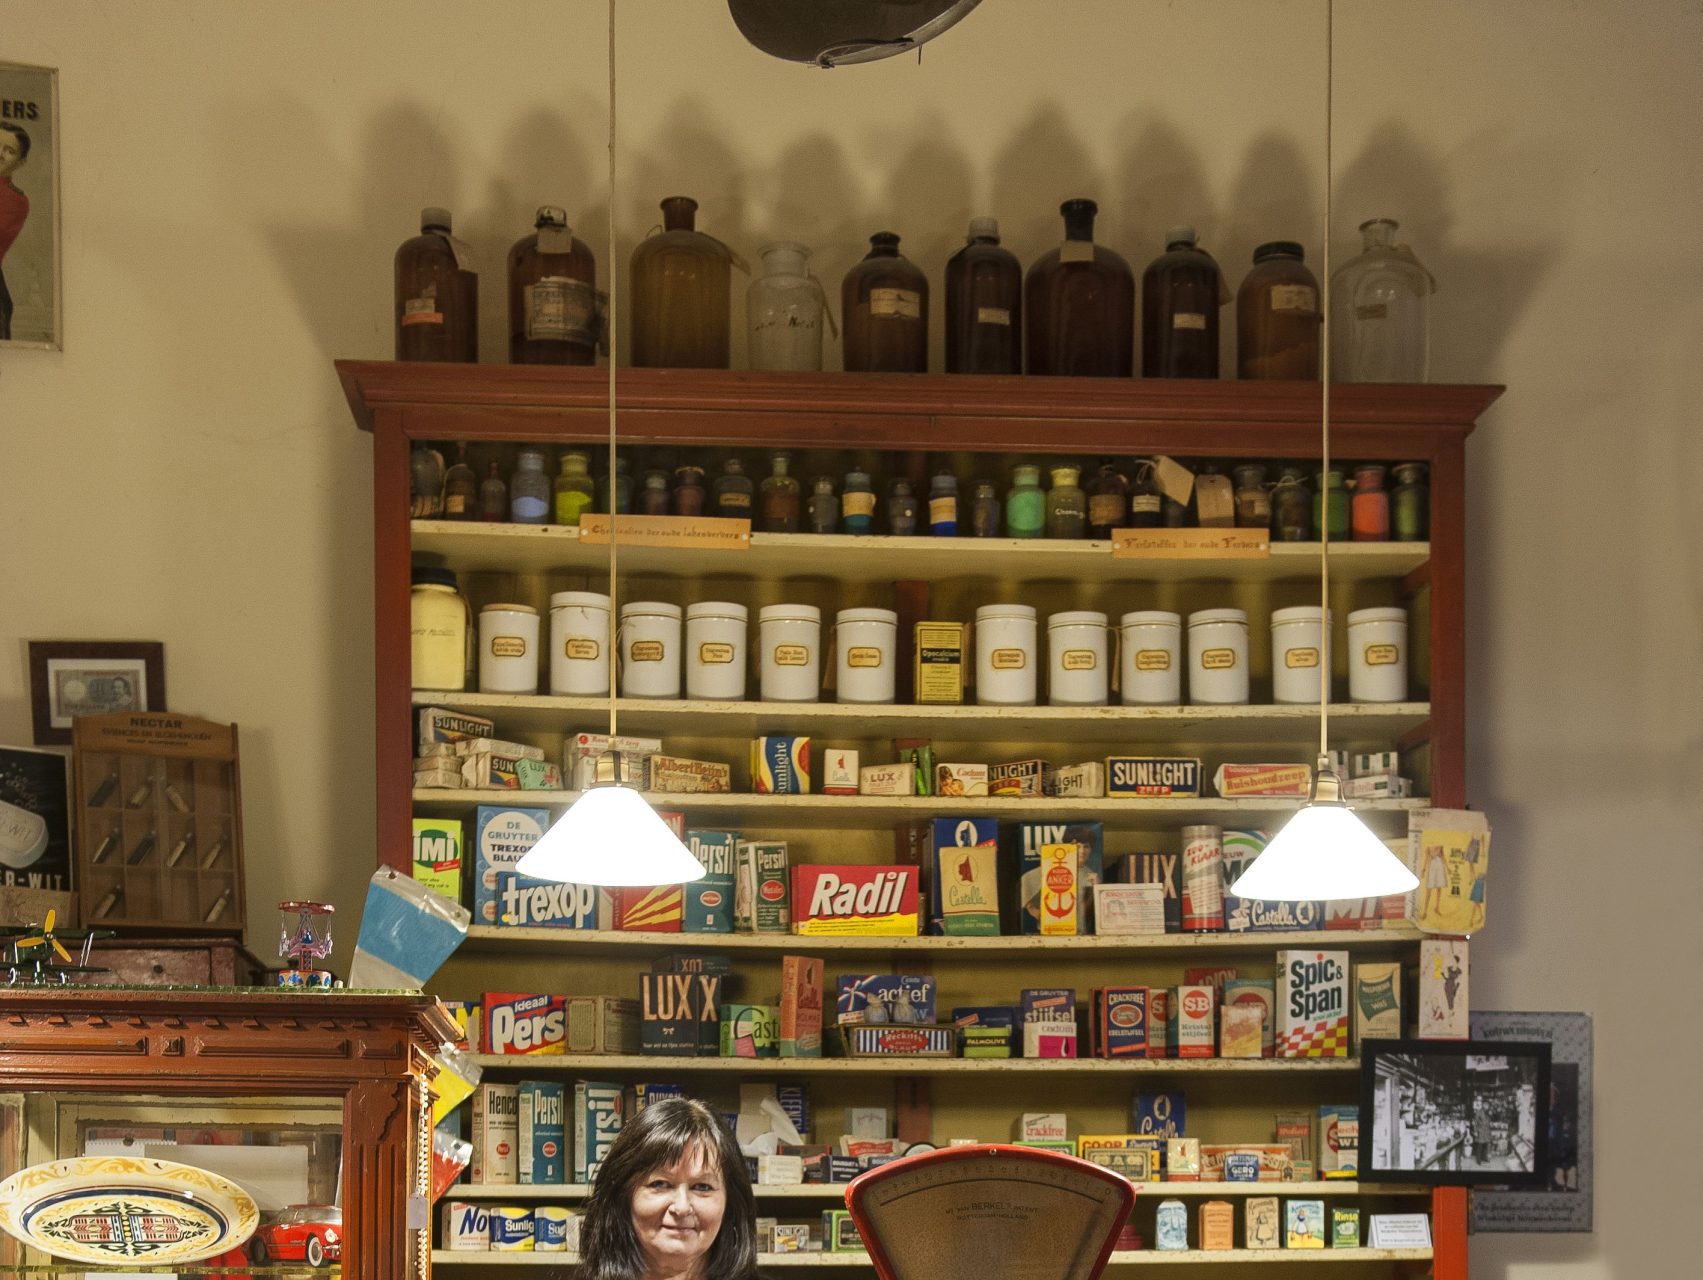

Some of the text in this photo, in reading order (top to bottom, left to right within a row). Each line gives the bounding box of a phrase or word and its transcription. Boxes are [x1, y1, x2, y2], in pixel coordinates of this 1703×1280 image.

[2, 101, 39, 120] ERS
[129, 717, 182, 729] NECTAR
[434, 716, 491, 737] SUNLIGHT
[870, 772, 895, 783] LUX
[1114, 762, 1195, 786] SUNLIGHT
[506, 821, 521, 830] DE
[487, 831, 538, 842] GRUYTER
[757, 850, 785, 873] Persil
[502, 877, 595, 928] trexop
[808, 872, 908, 916] Radil
[1290, 953, 1344, 991] Spic &
[514, 997, 549, 1012] Ideaal
[643, 975, 694, 1022] LUX
[1183, 997, 1211, 1012] SB
[1290, 986, 1342, 1020] Span
[492, 1005, 564, 1054] Pers
[966, 1038, 1006, 1046] PALMOLIVE
[489, 1090, 518, 1115] Henco
[534, 1089, 564, 1126] Persil
[1026, 1124, 1065, 1137] crackfree
[1334, 1212, 1359, 1222] Rinso
